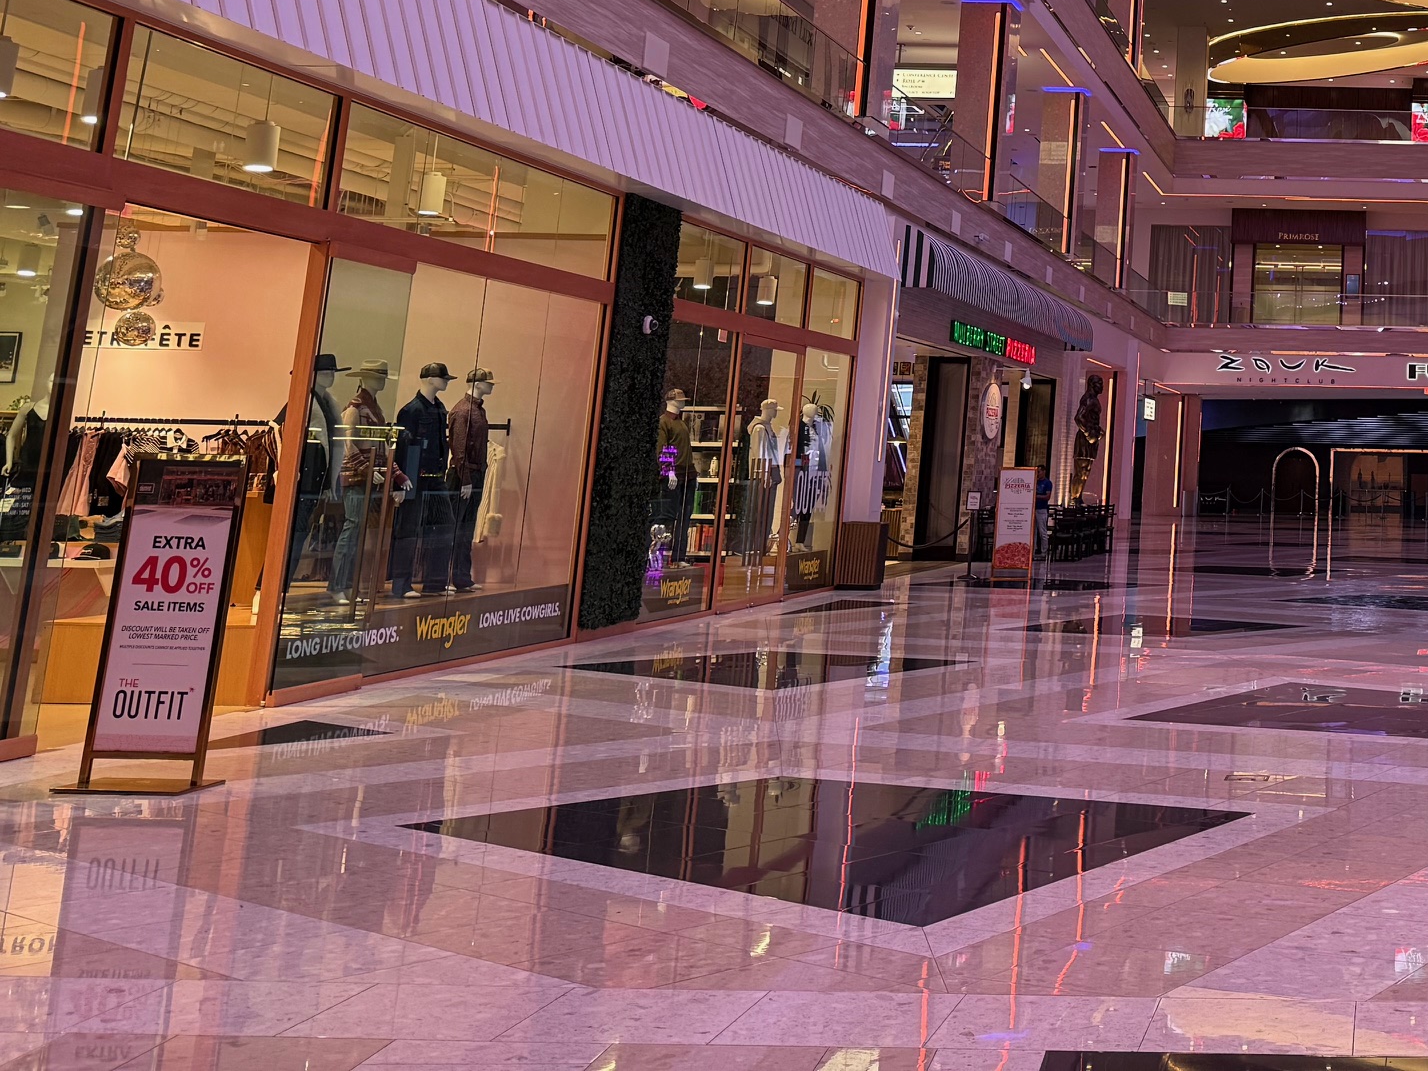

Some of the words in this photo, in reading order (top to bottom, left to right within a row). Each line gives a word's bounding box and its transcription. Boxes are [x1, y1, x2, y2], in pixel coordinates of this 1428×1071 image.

[986, 331, 1006, 356] STREET
[1006, 337, 1036, 365] PIZZERIA
[1216, 354, 1356, 373] ZOUK
[1236, 377, 1335, 385] NIGHTCLUB
[152, 535, 206, 550] EXTRA
[798, 557, 821, 580] Wrangler
[186, 582, 215, 594] OFF
[660, 577, 692, 604] Wrangler
[133, 600, 164, 612] SALE
[166, 601, 205, 613] ITEMS
[121, 625, 153, 633] DISCOUNT
[128, 632, 153, 640] LOWEST
[286, 638, 320, 659] LONG
[321, 633, 347, 653] LIVE
[416, 611, 471, 648] Wrangler
[479, 609, 504, 629] LONG
[504, 608, 521, 624] LIVE
[521, 602, 561, 621] COWGIRLS.
[119, 678, 139, 688] THE
[112, 689, 188, 720] OUTFIT
